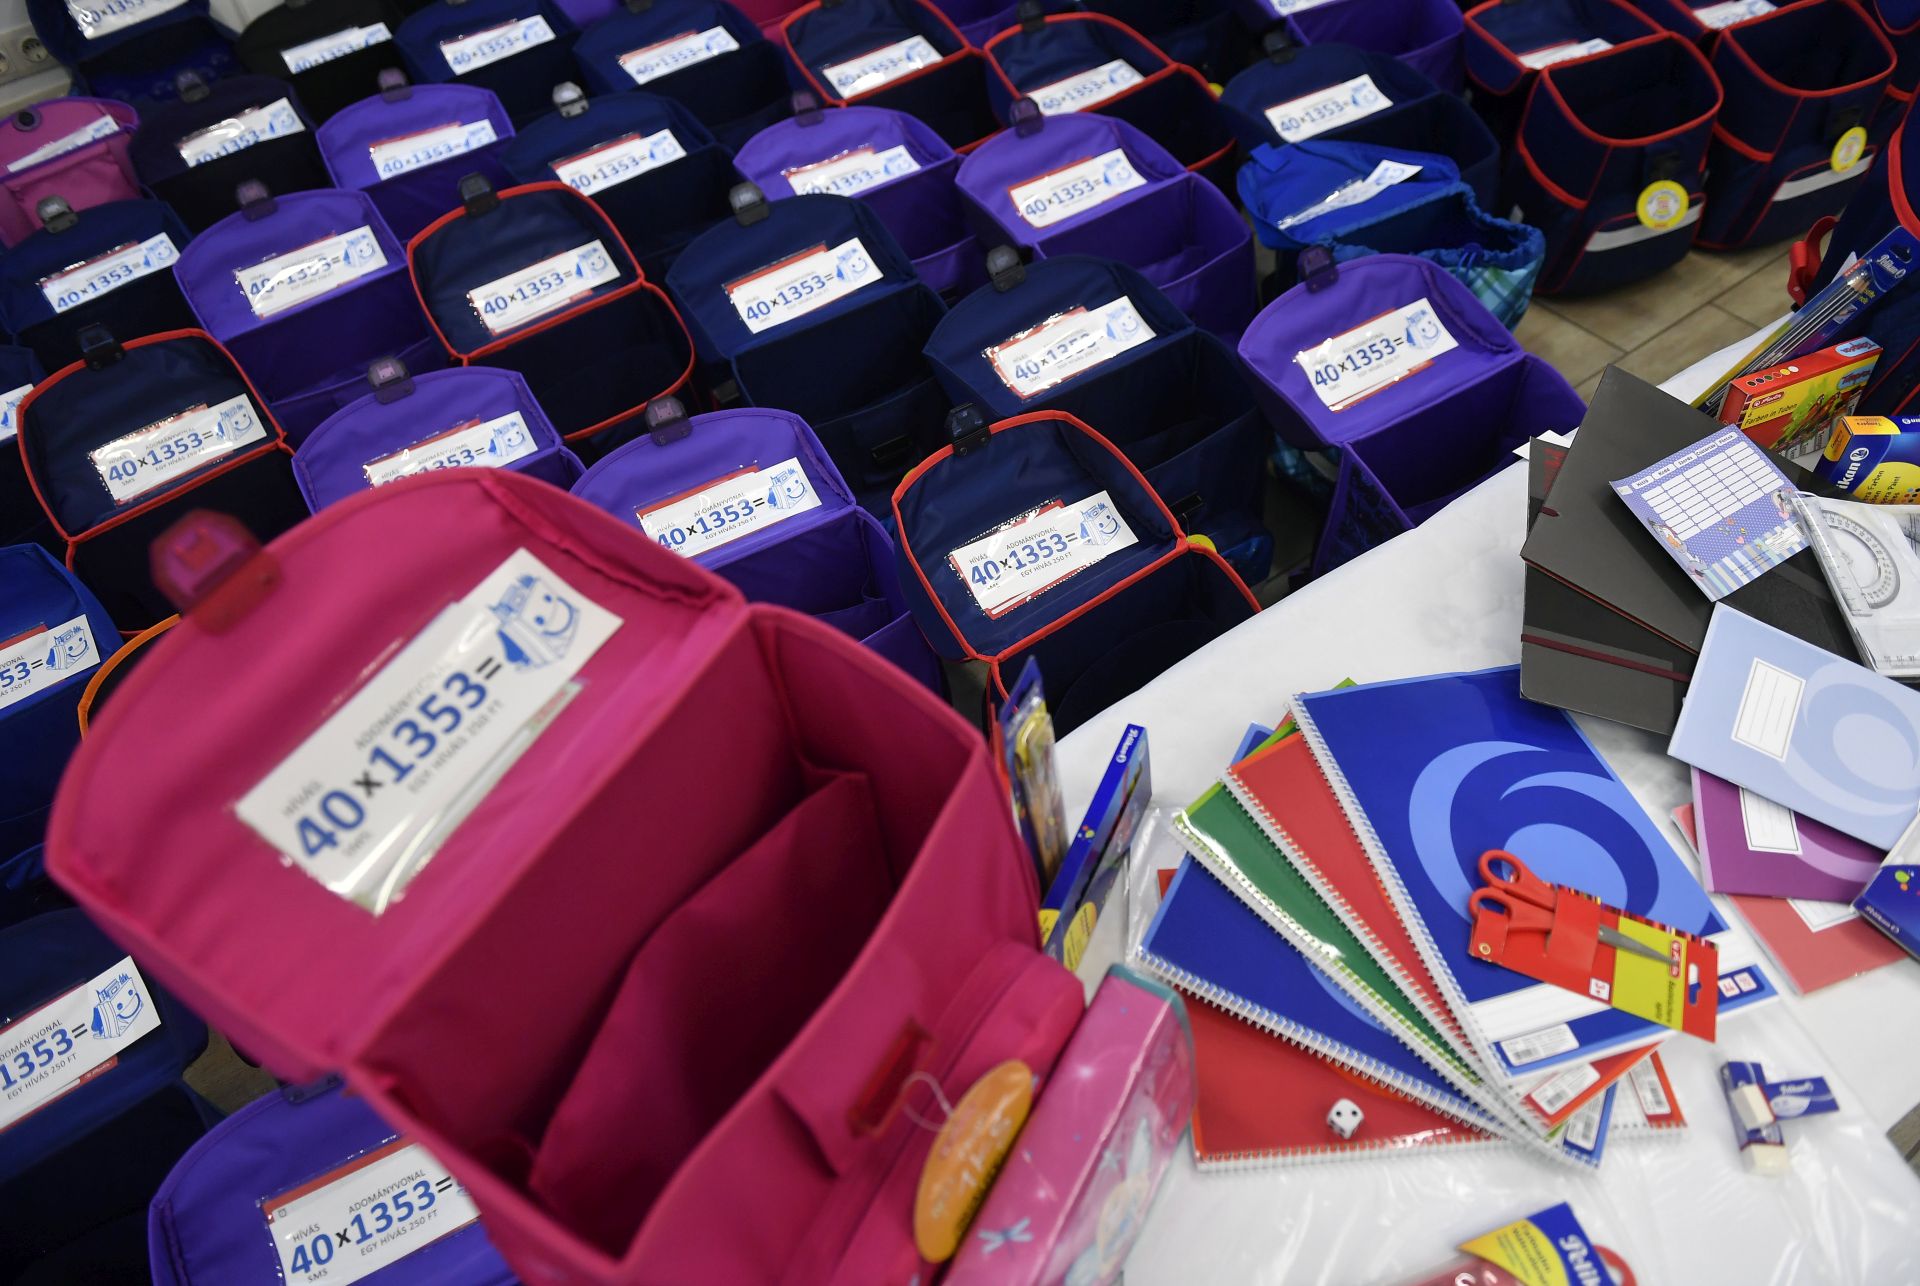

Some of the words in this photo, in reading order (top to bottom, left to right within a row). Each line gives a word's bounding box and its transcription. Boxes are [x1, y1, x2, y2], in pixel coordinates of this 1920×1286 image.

[7, 1087, 23, 1100] EGY
[25, 1071, 49, 1089] HÍVÁS
[51, 1060, 66, 1074] 250
[67, 1052, 77, 1064] FT
[293, 1223, 321, 1243] HÍVÁS
[349, 1169, 426, 1214] ADOMÁNYVONAL
[360, 1242, 378, 1256] EGY
[380, 1226, 408, 1246] HÍVÁS
[409, 1216, 426, 1231] 250
[428, 1209, 438, 1222] FT
[307, 1268, 328, 1283] SMS
